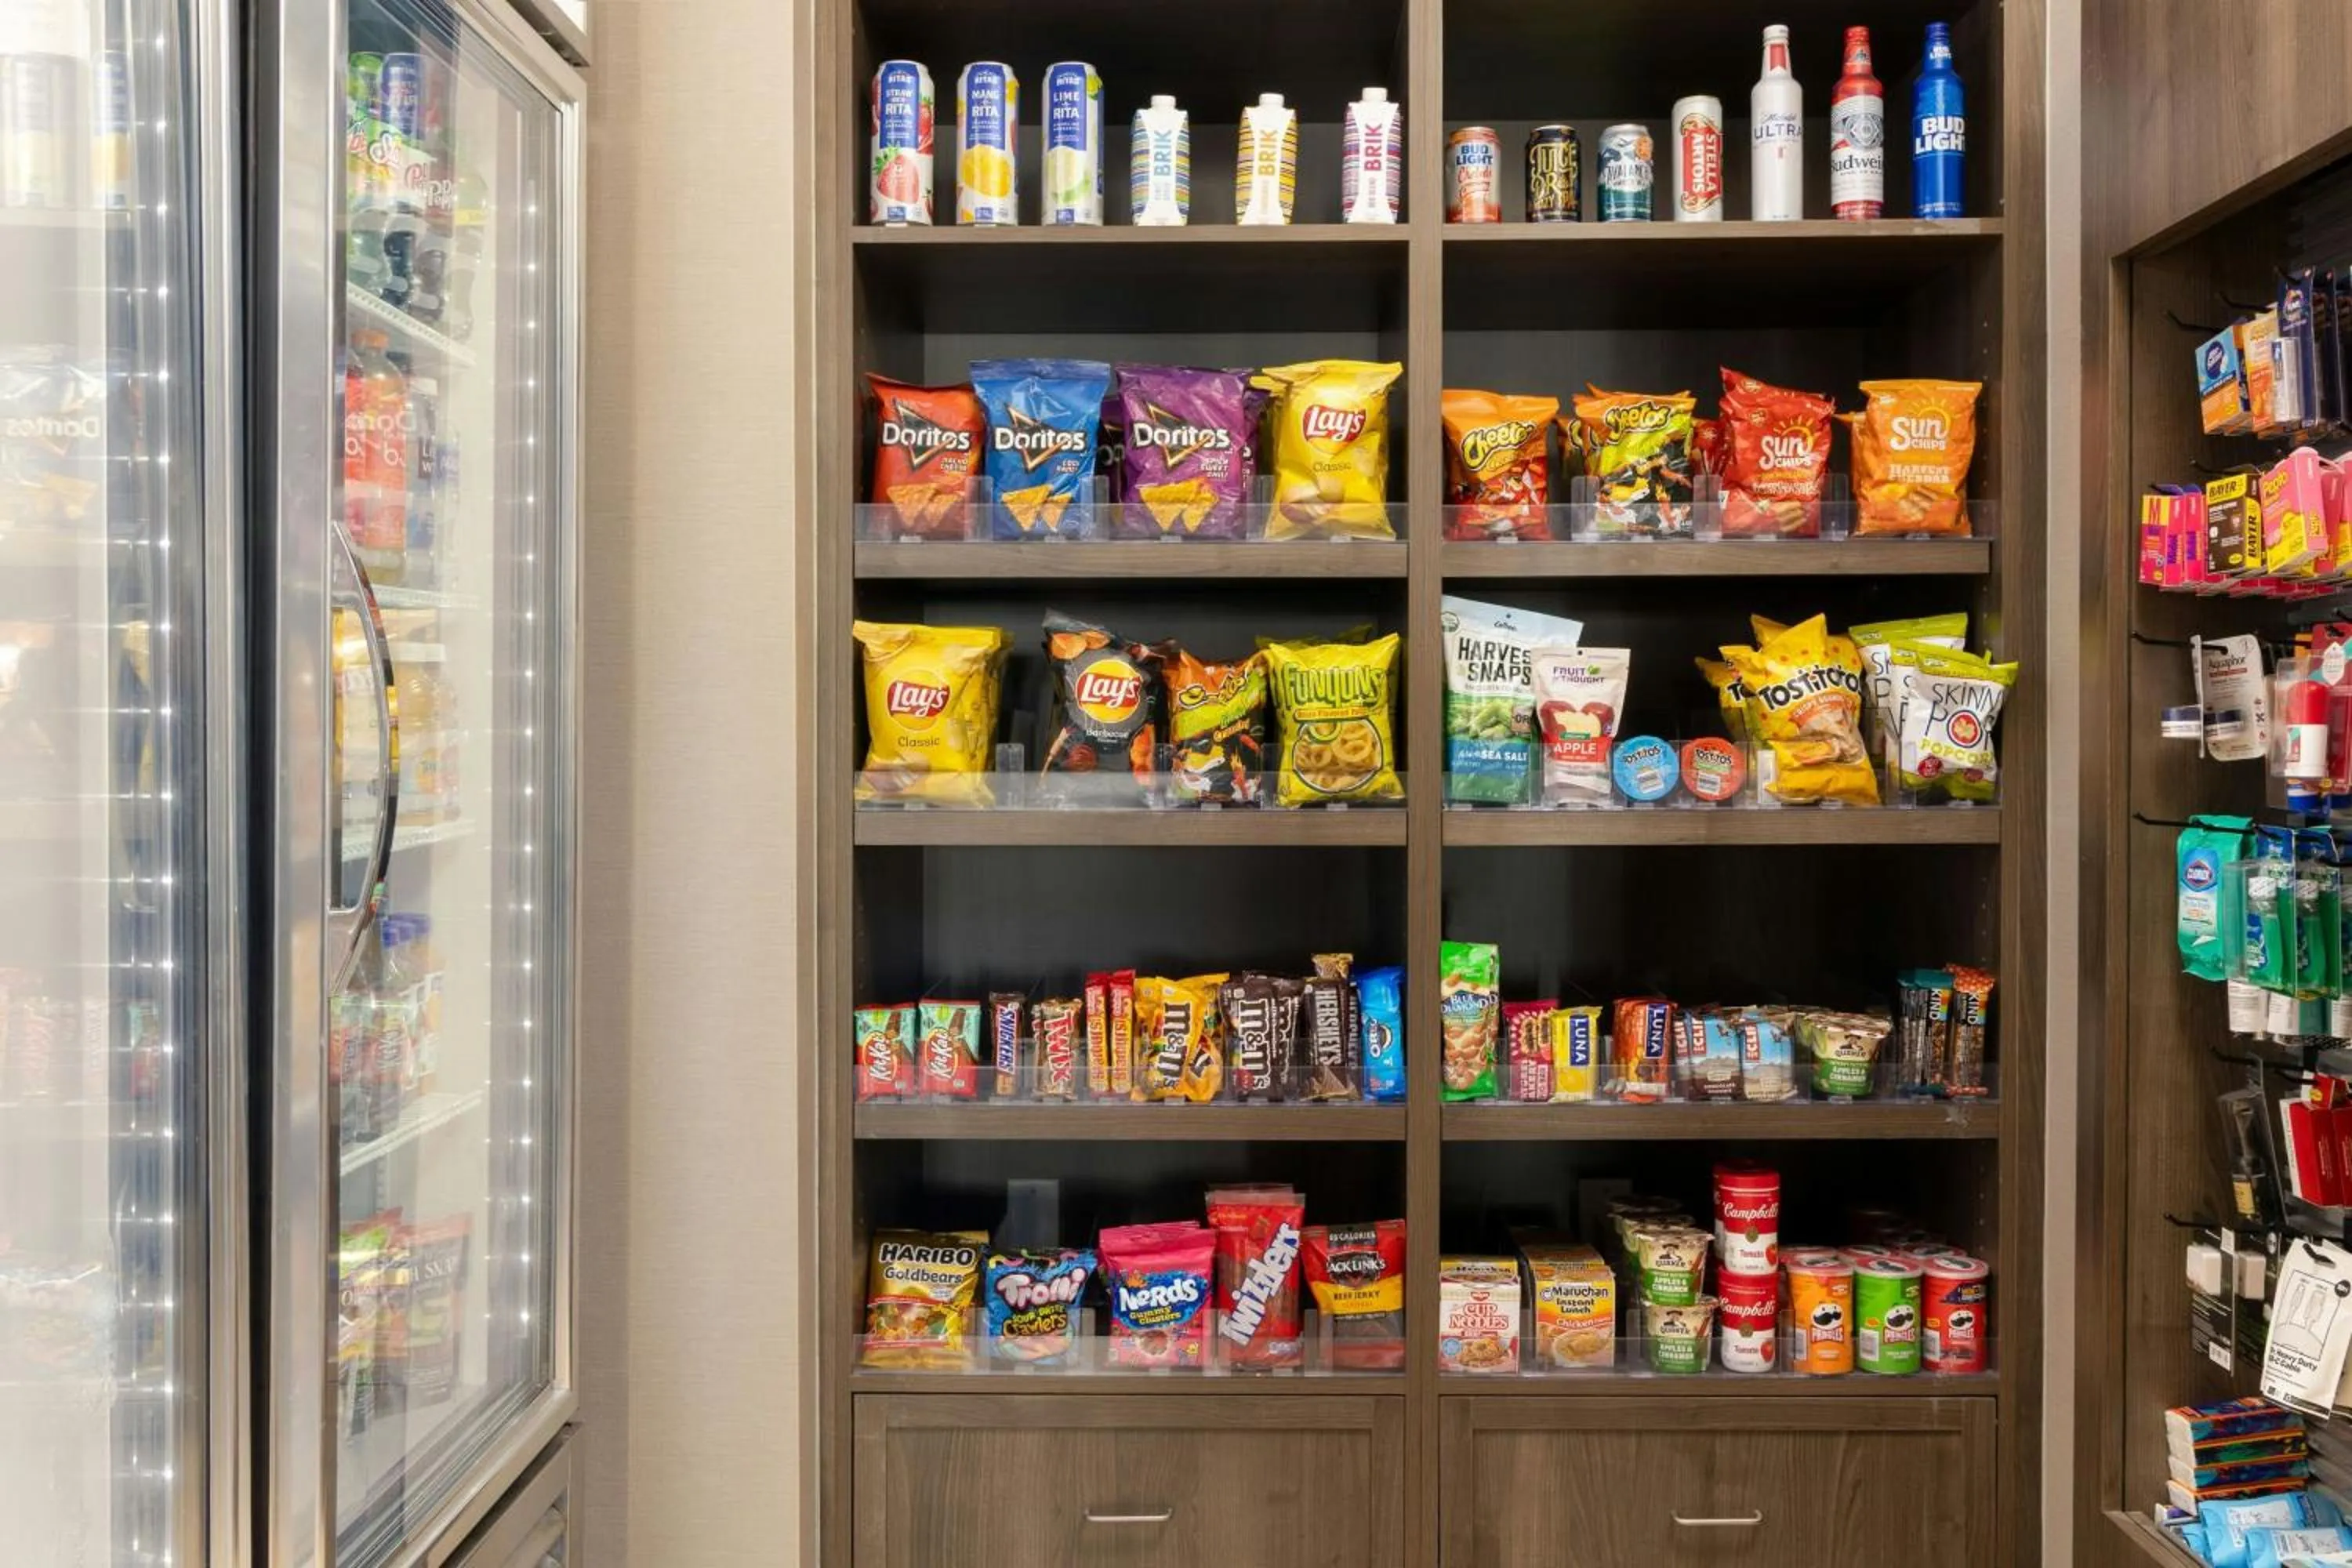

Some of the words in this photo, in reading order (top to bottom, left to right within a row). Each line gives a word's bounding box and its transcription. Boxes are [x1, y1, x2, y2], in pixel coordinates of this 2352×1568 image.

[885, 103, 912, 115] RITA
[1054, 91, 1080, 102] LIME
[971, 106, 998, 118] RITA
[1053, 108, 1080, 120] RITA
[1754, 124, 1803, 140] ULTRA
[1922, 117, 1965, 135] BUD
[1153, 129, 1172, 176] BRIK
[1258, 129, 1278, 176] BRIK
[1363, 122, 1383, 172] BRIK
[1456, 154, 1494, 166] LIGHT
[1461, 144, 1489, 154] BUD
[1691, 132, 1704, 194] ARTOIS
[1704, 132, 1717, 193] STELLA
[1133, 422, 1231, 448] Doritos
[1307, 405, 1365, 441] Lay's
[1606, 402, 1671, 445] Cheetos
[1889, 416, 1949, 451] Sun
[883, 422, 971, 451] Doritos
[994, 426, 1086, 452] Doritos
[1463, 423, 1534, 468] Cheeto
[1911, 439, 1947, 451] CHIPS
[1759, 435, 1812, 471] Sun
[2209, 480, 2238, 498] BAYER
[2247, 514, 2258, 559] BAYER
[1458, 637, 1531, 666] HARVES
[1467, 661, 1531, 686] SNAPS
[1553, 666, 1586, 676] FRUIT
[1560, 675, 1606, 684] THOUGHT
[890, 680, 948, 717] Lay's
[1080, 673, 1140, 707] Lay's
[1283, 662, 1386, 710] FUNYUNS
[1932, 681, 2002, 713] SKINN
[898, 735, 941, 747] Classic
[1554, 742, 1597, 753] APPLE
[1920, 738, 1993, 764] POPCOR
[1480, 750, 1501, 760] SEA
[1504, 752, 1528, 761] SALT
[1929, 987, 1942, 1021] KIND
[1967, 990, 1979, 1025] KIND
[997, 1007, 1016, 1074] SNICKERS
[1315, 989, 1342, 1066] HERSHEY'S
[1368, 1018, 1382, 1058] OREO
[1575, 1018, 1588, 1063] LUNA
[1650, 1008, 1664, 1054] LUNA
[1044, 1009, 1074, 1085] TWIX
[1528, 1058, 1537, 1099] AKERY
[880, 1243, 976, 1266] HARIBO
[1740, 1250, 1765, 1258] Tomato
[884, 1267, 964, 1284] Goldbears
[996, 1268, 1087, 1308] Trolli
[1354, 1290, 1381, 1299] JERKY
[1552, 1287, 1610, 1298] Maruchan
[1556, 1298, 1595, 1306] Instant
[1463, 1302, 1498, 1317] CUP
[1560, 1305, 1592, 1314] Lunch
[1719, 1297, 1776, 1317] Campbell's
[1003, 1314, 1067, 1337] Crawlers
[1449, 1315, 1509, 1330] NOODLES
[1733, 1345, 1759, 1354] Tomato
[2297, 1357, 2318, 1372] Duty
